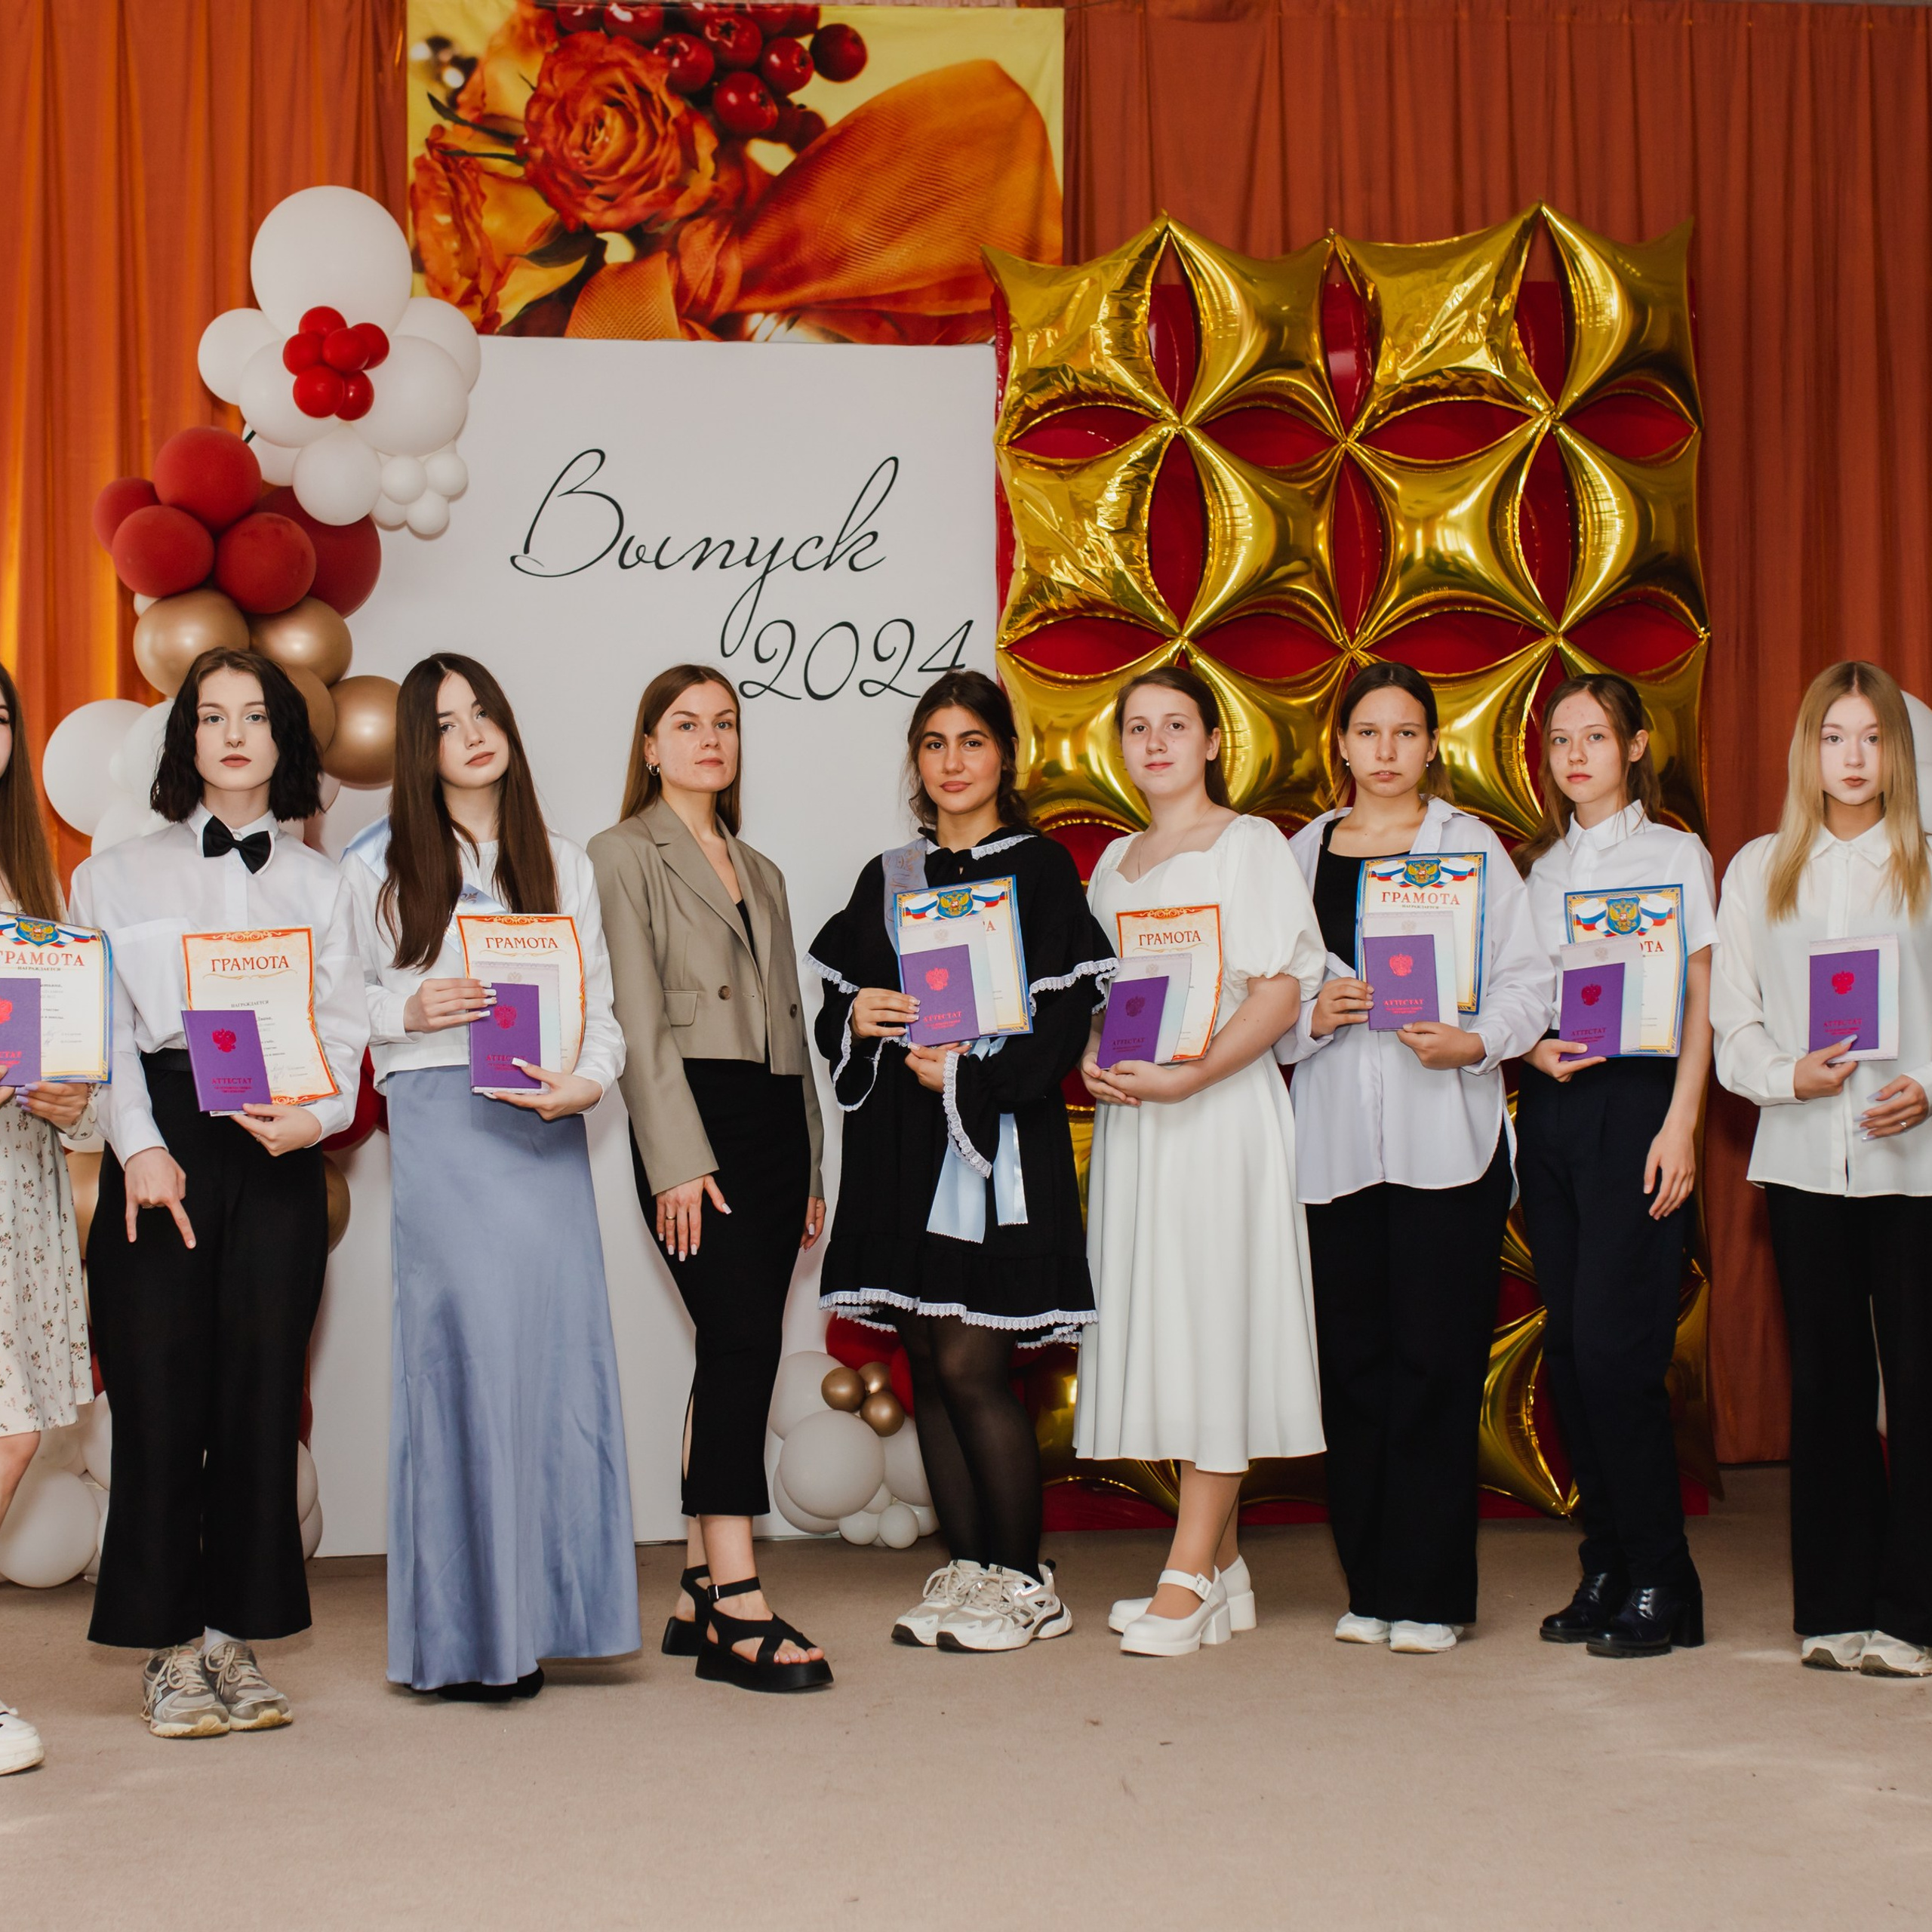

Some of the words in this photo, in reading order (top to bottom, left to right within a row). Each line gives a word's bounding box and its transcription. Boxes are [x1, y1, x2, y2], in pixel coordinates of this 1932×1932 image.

[510, 449, 899, 657] Выпуск
[739, 619, 974, 700] 2024
[1381, 891, 1460, 905] ГРАМОТА
[485, 937, 558, 949] ГРАМОТА
[1138, 930, 1201, 946] ГРАМОТА
[211, 955, 290, 972] ГРАМОТА
